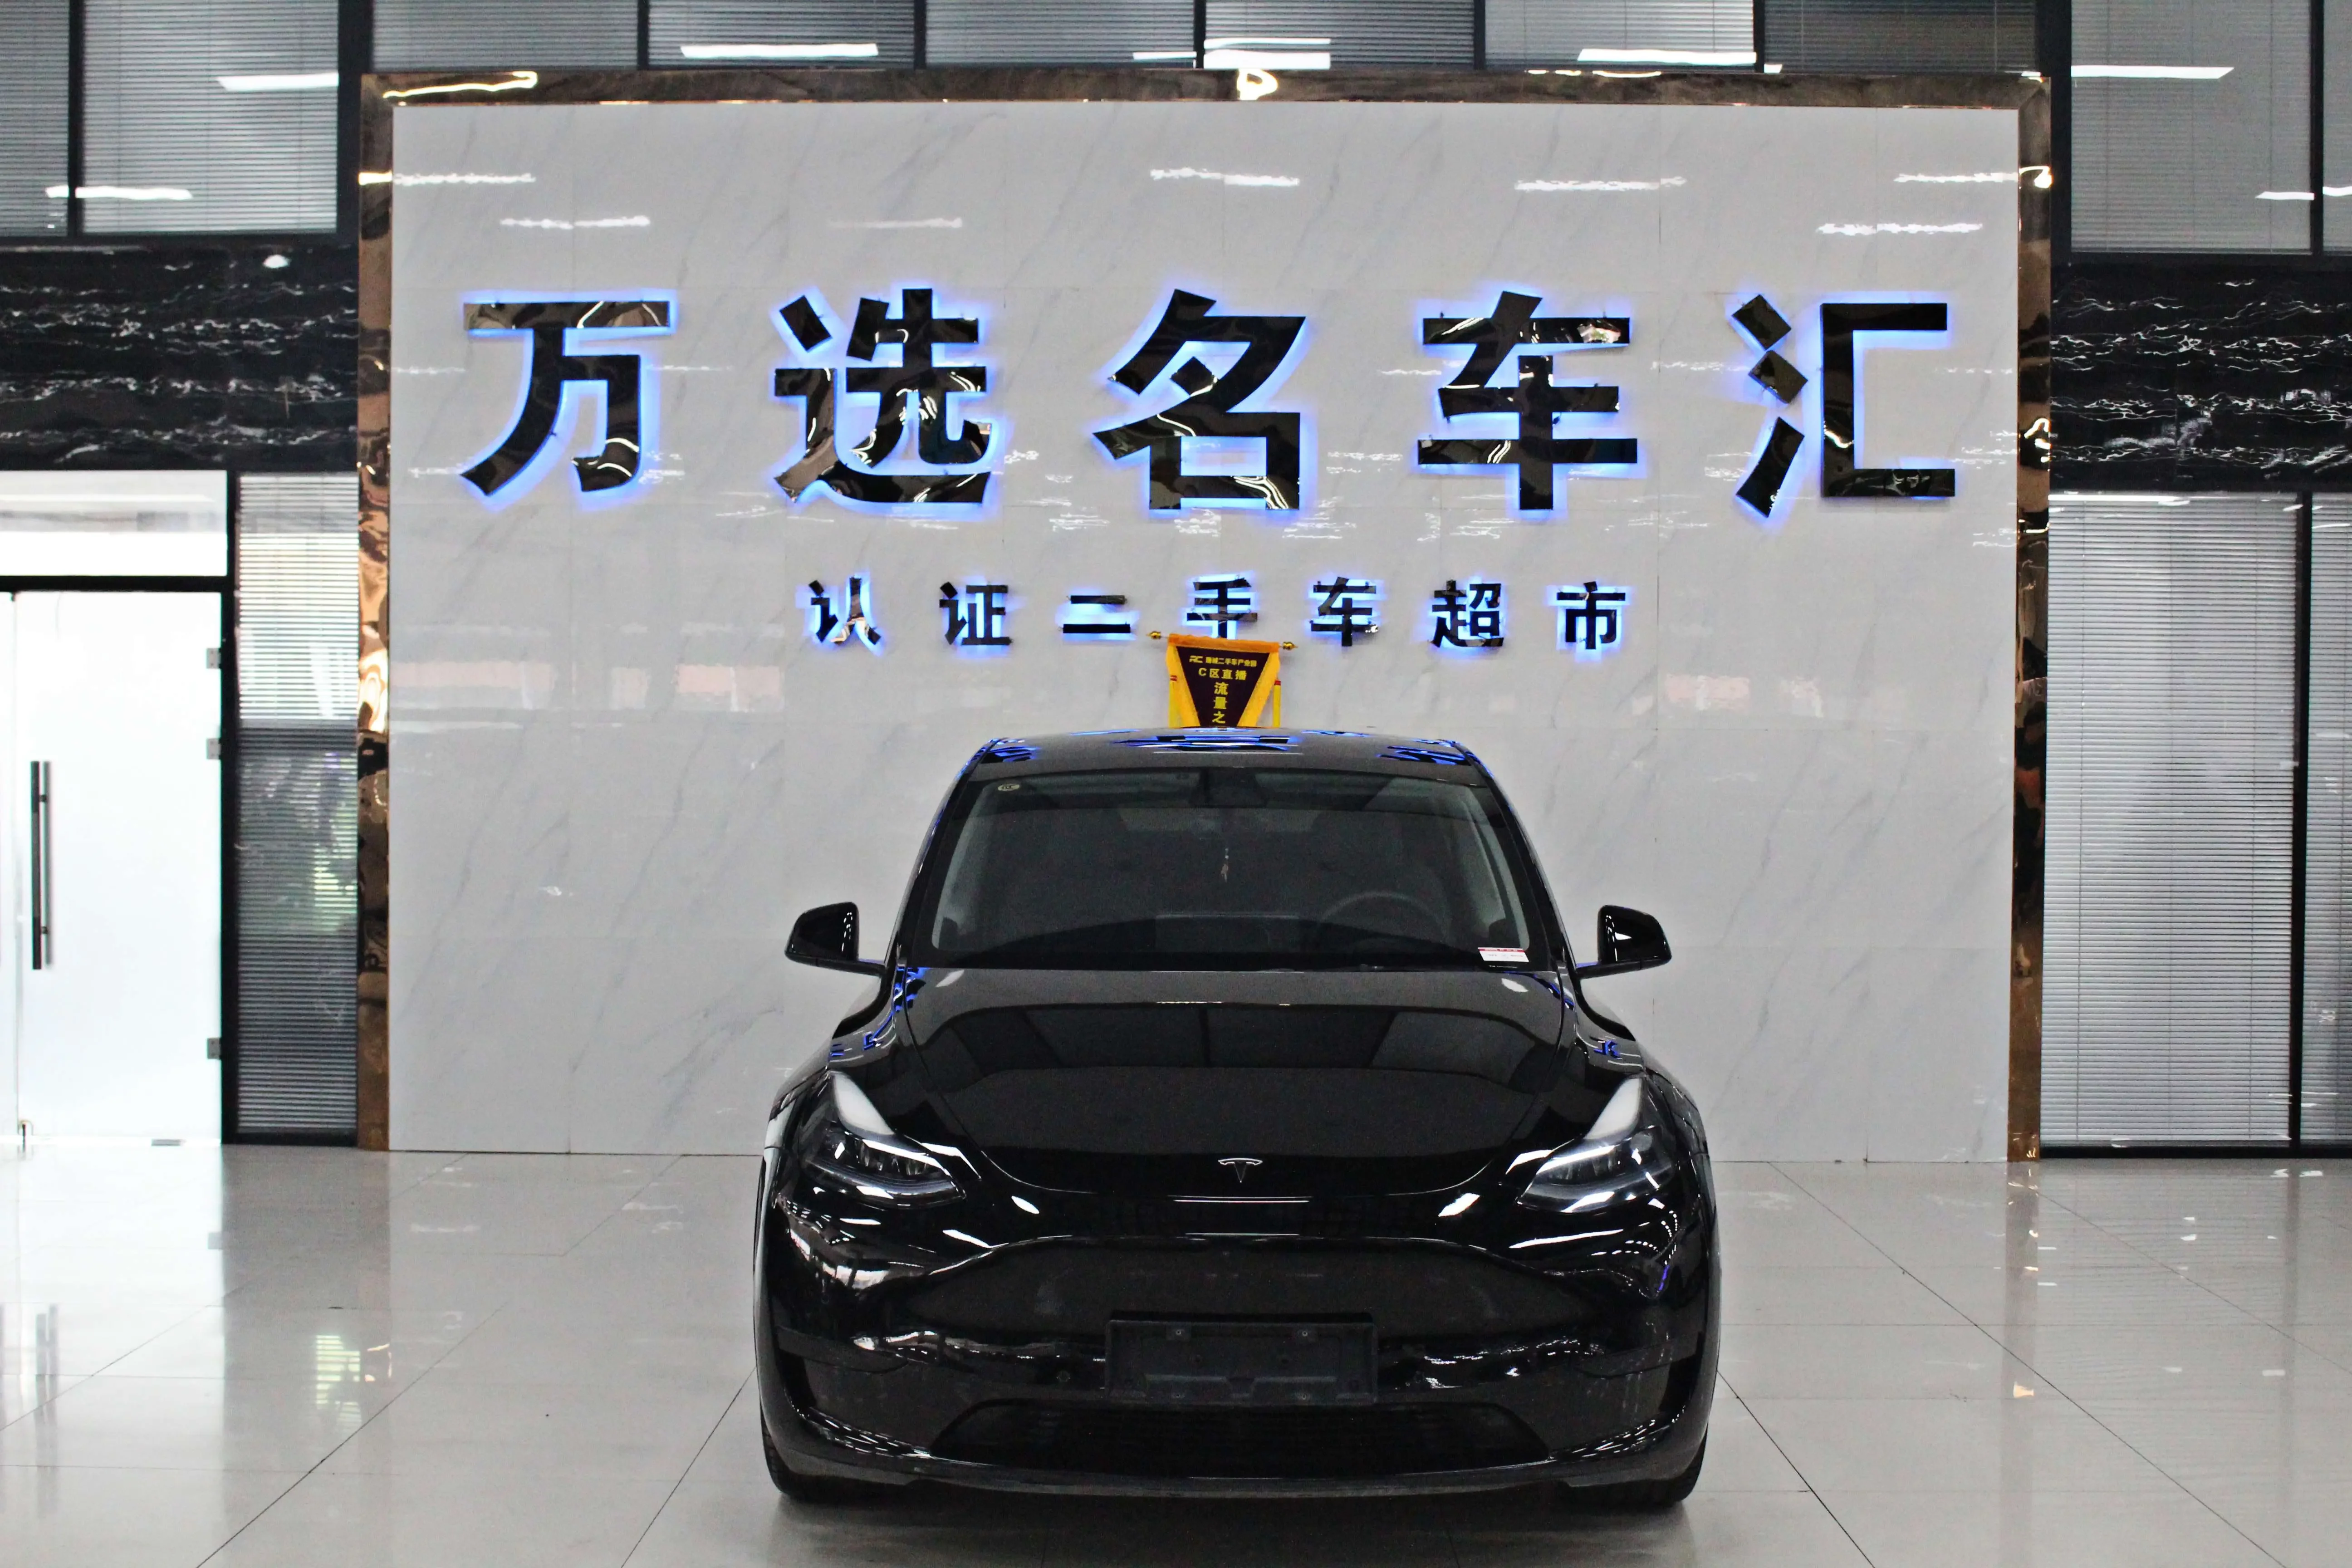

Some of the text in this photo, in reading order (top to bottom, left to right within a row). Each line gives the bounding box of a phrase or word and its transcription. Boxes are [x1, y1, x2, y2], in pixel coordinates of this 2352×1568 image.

[463, 289, 1955, 516] 万选名车汇
[809, 577, 1626, 650] 认证二手车超市
[1198, 667, 1247, 681] C区直播
[1212, 682, 1229, 724] 流量之
